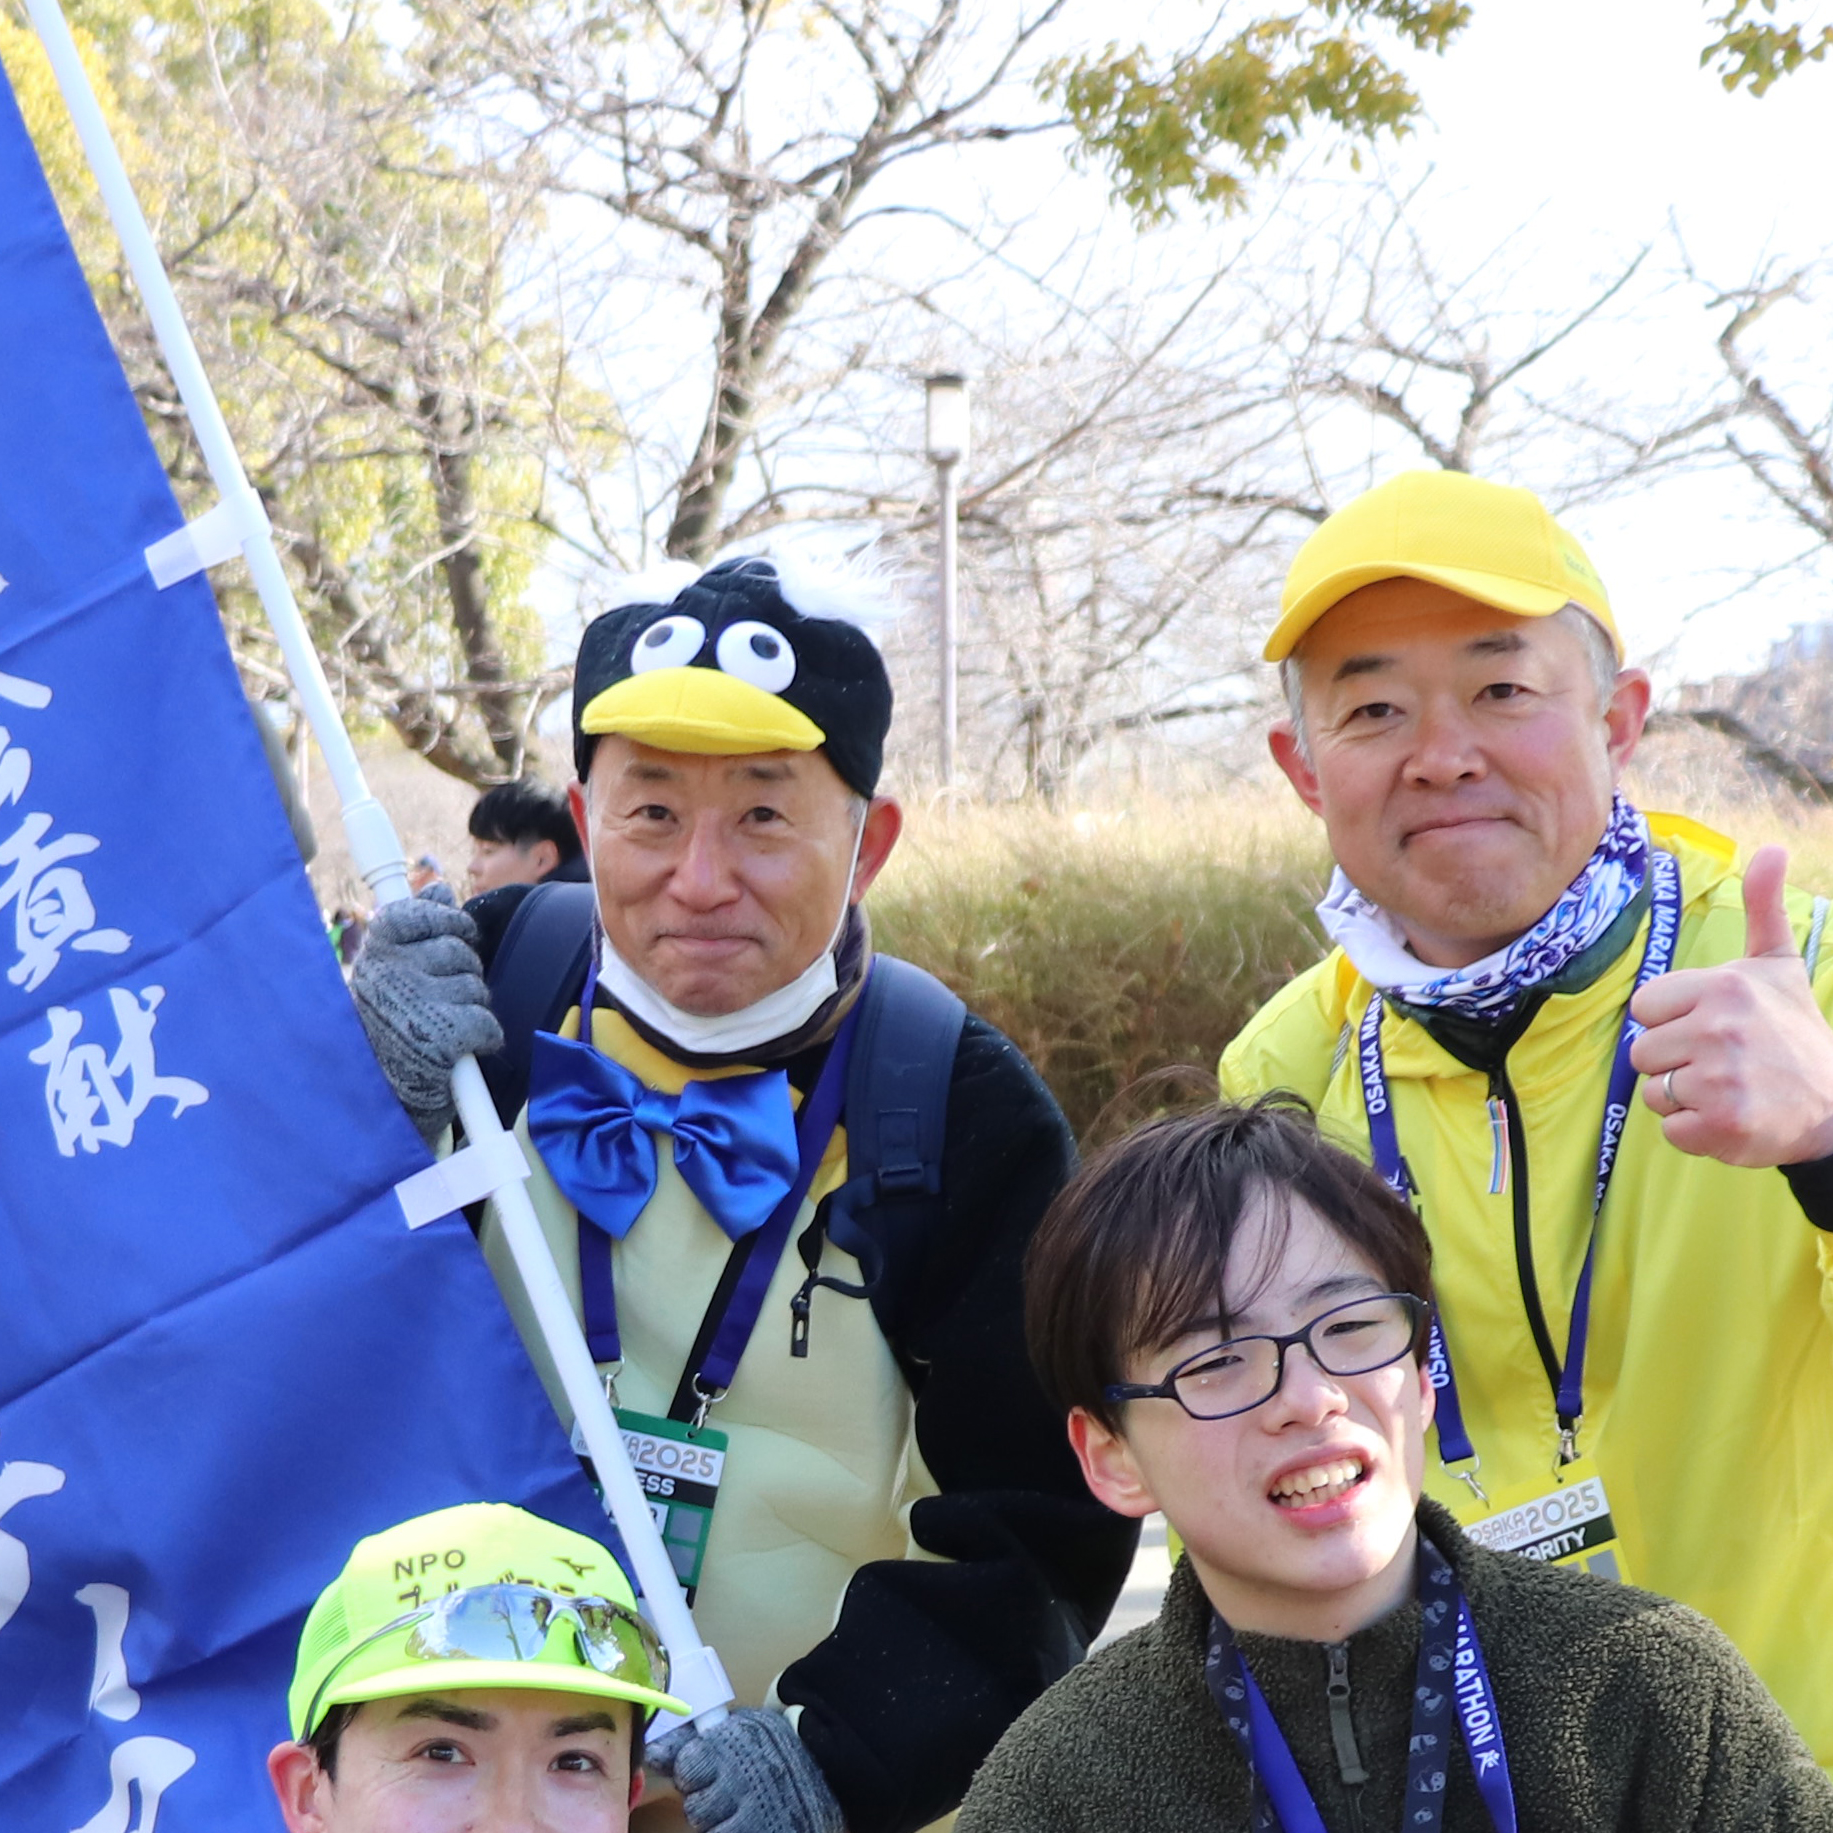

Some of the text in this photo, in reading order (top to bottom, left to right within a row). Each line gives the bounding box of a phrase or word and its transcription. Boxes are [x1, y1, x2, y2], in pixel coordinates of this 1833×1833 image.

[1362, 1040, 1387, 1115] OSAKA
[638, 1439, 717, 1478] 2025
[1469, 1483, 1600, 1546] OSAKA 2025
[394, 1549, 466, 1581] NPO
